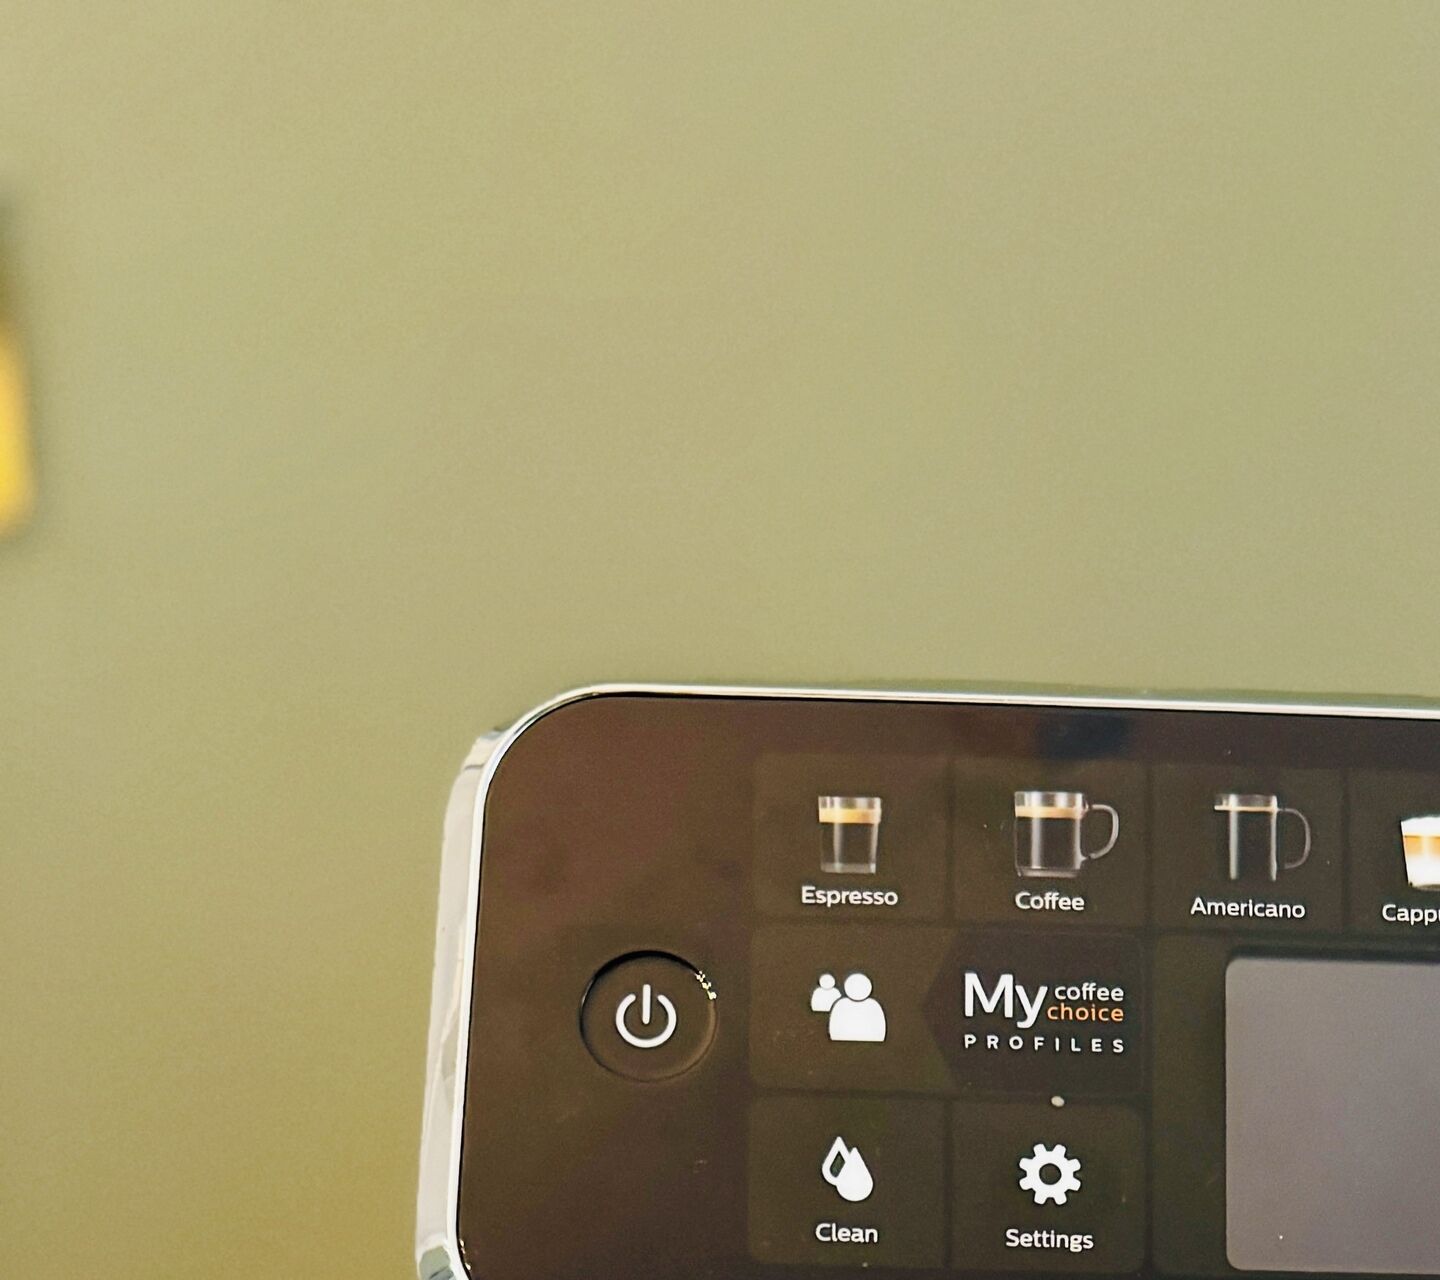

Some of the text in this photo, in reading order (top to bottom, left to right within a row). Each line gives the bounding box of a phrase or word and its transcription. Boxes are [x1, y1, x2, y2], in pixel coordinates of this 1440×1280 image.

[801, 884, 899, 909] Espresso
[1014, 890, 1085, 911] Coffee
[1190, 896, 1306, 919] Americano
[964, 971, 1124, 1029] My coffee
[1046, 1002, 1125, 1022] choice
[963, 1033, 1124, 1053] PROFILES
[815, 1222, 879, 1243] Clean
[1005, 1228, 1094, 1253] Settings
